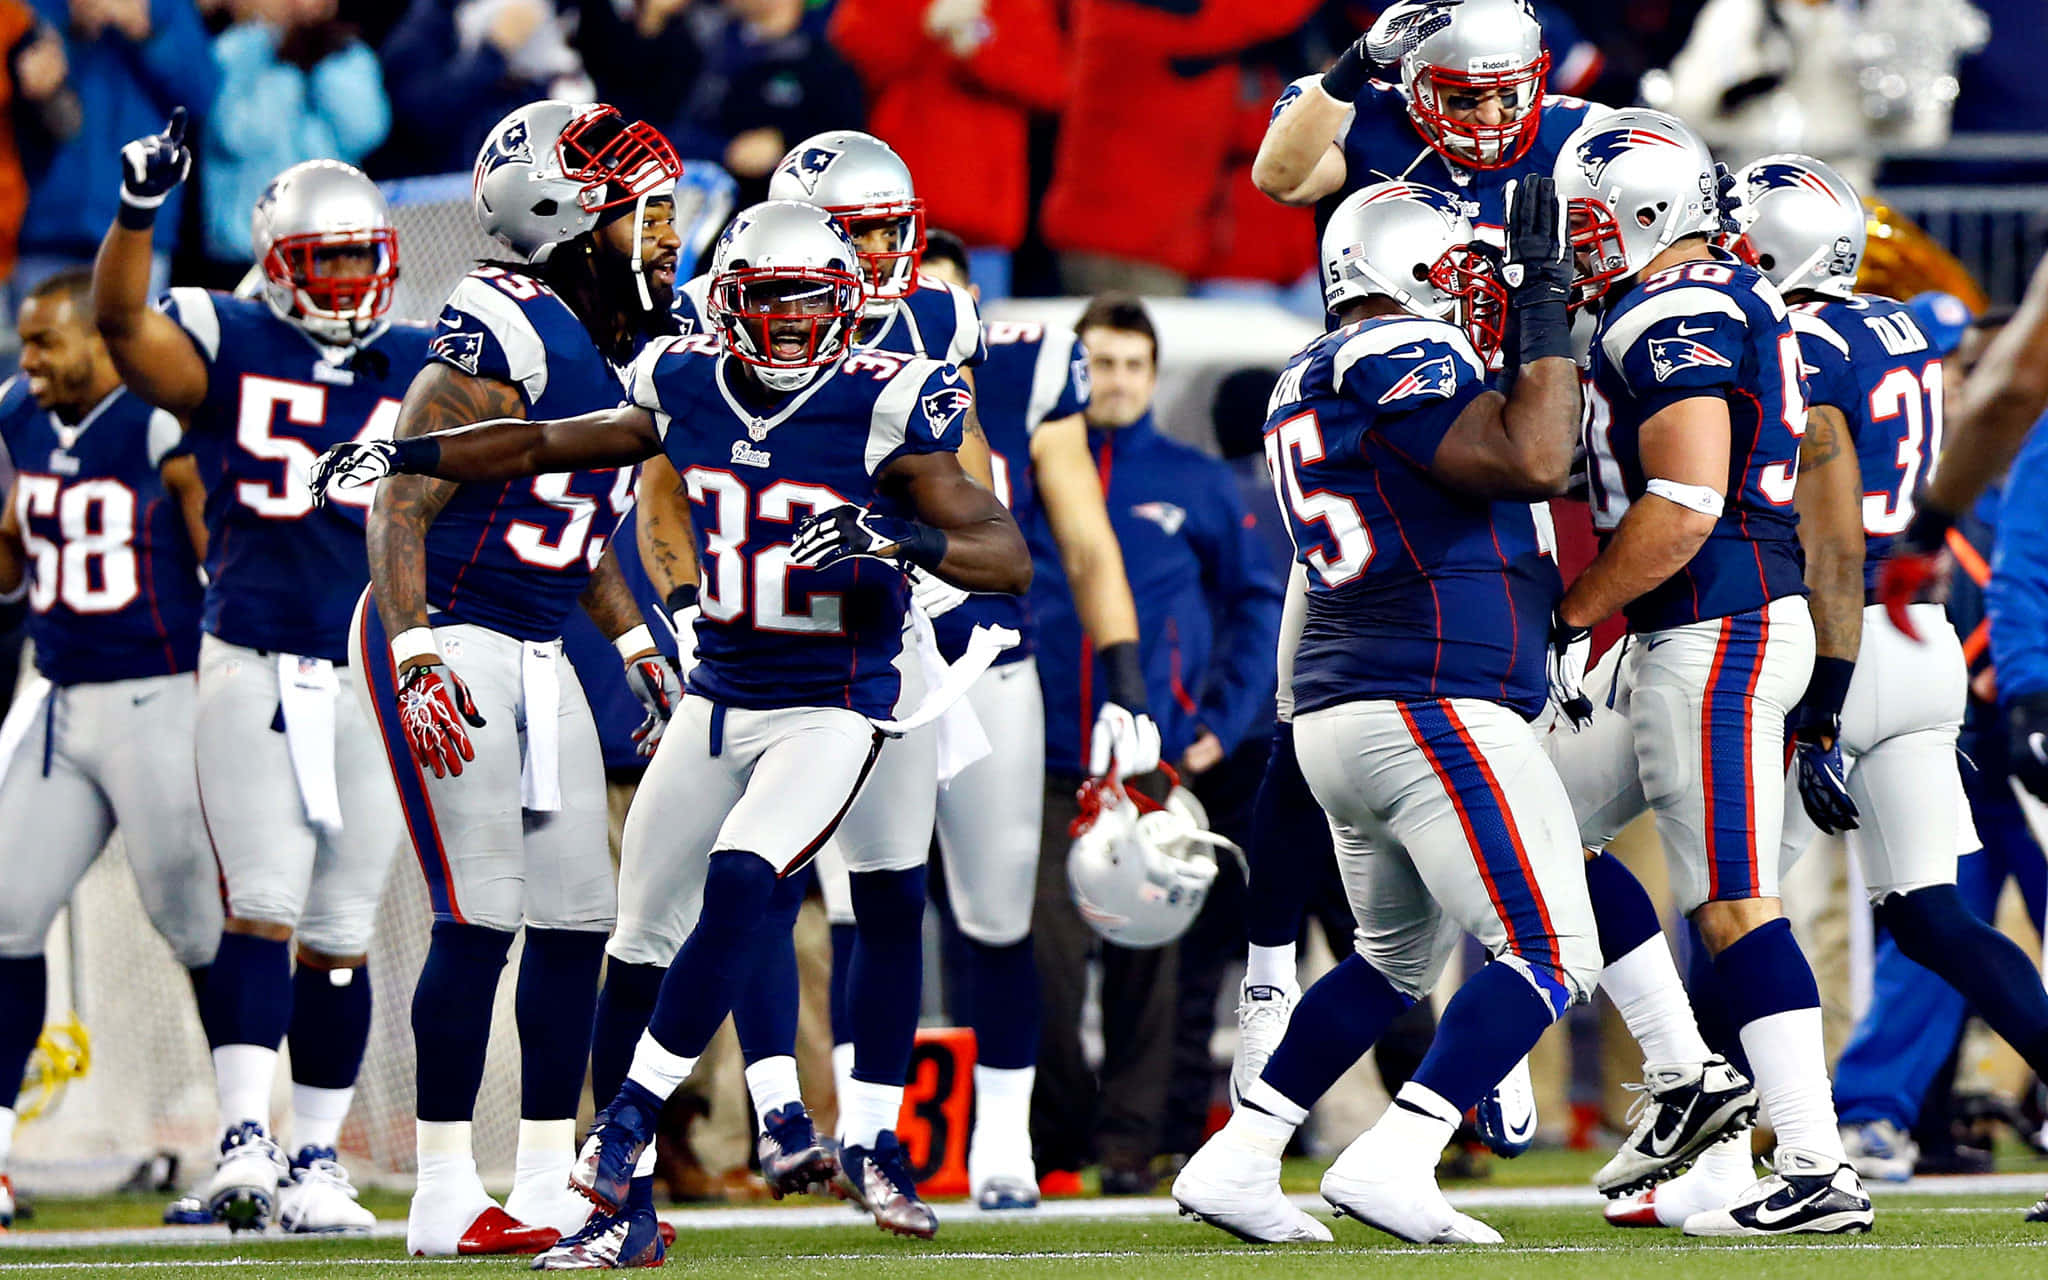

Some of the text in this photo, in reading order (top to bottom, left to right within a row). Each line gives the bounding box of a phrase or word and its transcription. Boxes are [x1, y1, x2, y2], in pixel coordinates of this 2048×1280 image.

[1328, 260, 1341, 283] 5
[1264, 409, 1377, 589] 75
[1862, 359, 1944, 536] 31
[16, 470, 141, 615] 58
[682, 464, 847, 637] 32
